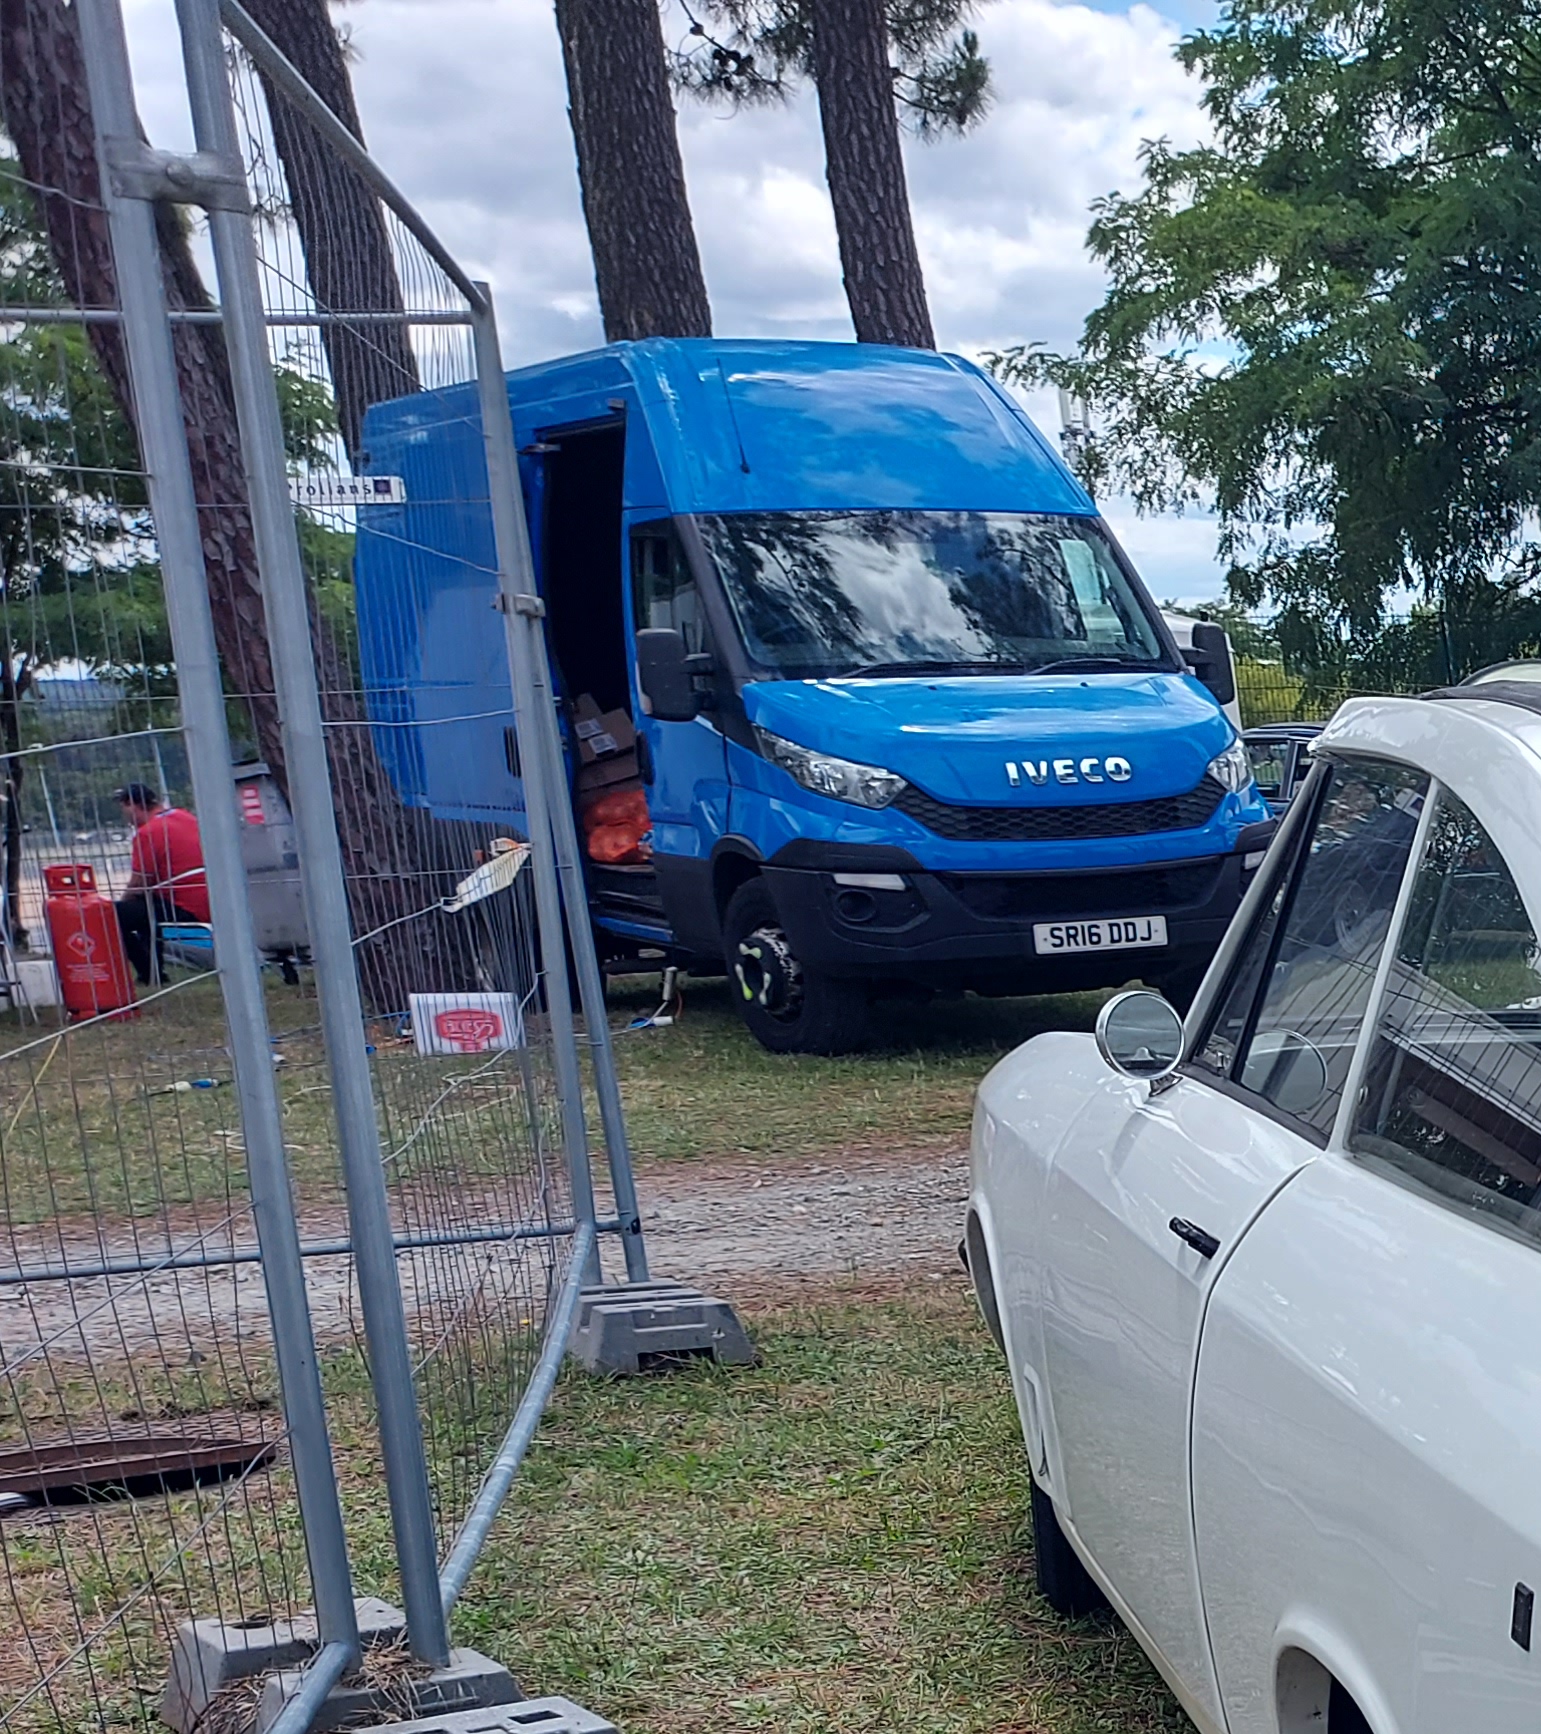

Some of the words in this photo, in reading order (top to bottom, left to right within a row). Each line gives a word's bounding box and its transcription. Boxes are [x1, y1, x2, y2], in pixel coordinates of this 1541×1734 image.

[289, 483, 372, 497] rolians
[1005, 757, 1132, 786] IVECO
[1050, 924, 1102, 948] SR16
[1108, 920, 1152, 944] DDJ
